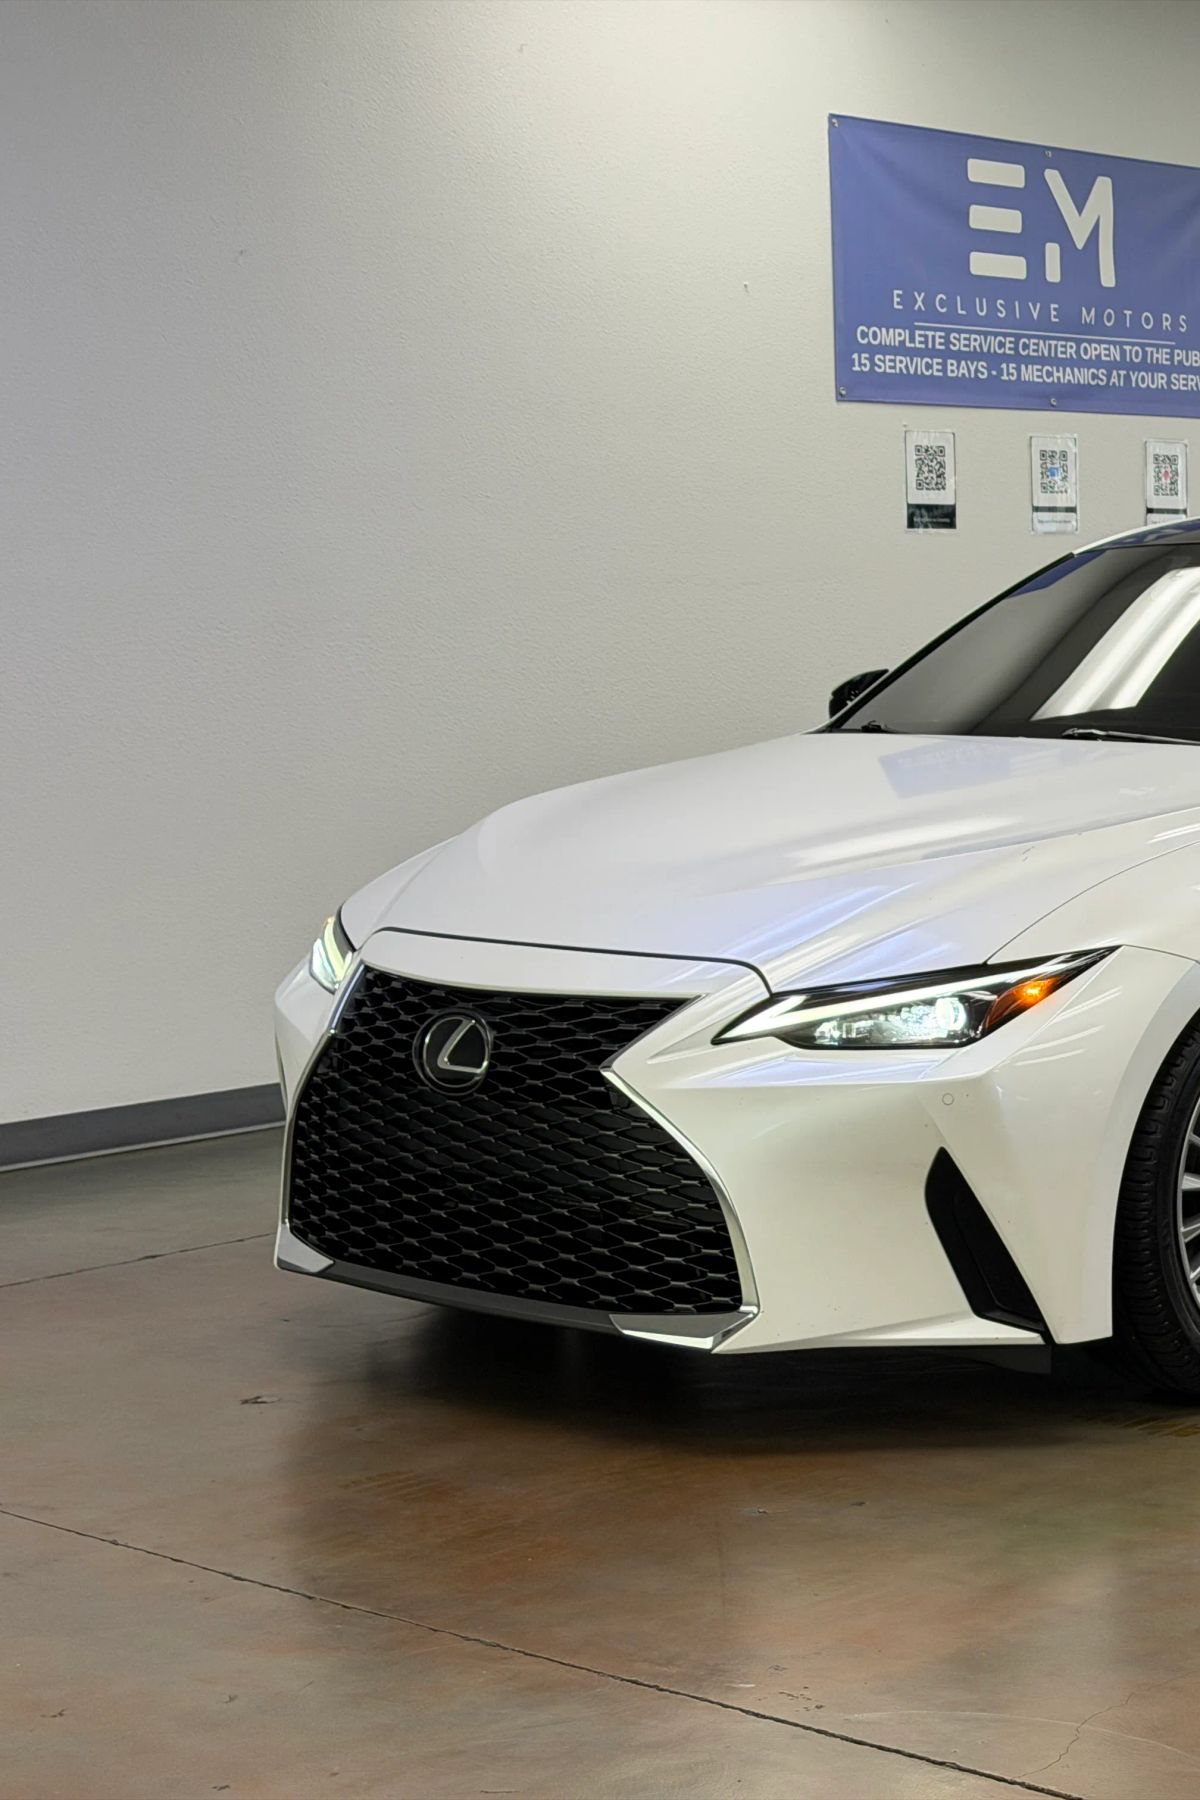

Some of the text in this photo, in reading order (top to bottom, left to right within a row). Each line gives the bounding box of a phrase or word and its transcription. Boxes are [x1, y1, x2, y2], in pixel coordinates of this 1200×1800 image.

[967, 158, 1116, 288] EM
[893, 289, 1187, 333] EXCLUSIVE MOTORS
[856, 325, 945, 349] COMPLETE
[949, 333, 1015, 355] SERVICE
[1018, 338, 1077, 359] CENTER
[1080, 342, 1120, 362] OPEN
[1123, 345, 1142, 363] TO
[1145, 347, 1171, 365] THE
[851, 352, 870, 372] 15
[874, 354, 943, 376] SERVICE
[947, 359, 988, 379] BAYS
[1000, 362, 1017, 381] 15
[1021, 364, 1107, 386] MECHANICS
[1109, 369, 1127, 387] AT
[1130, 371, 1167, 389] YOUR
